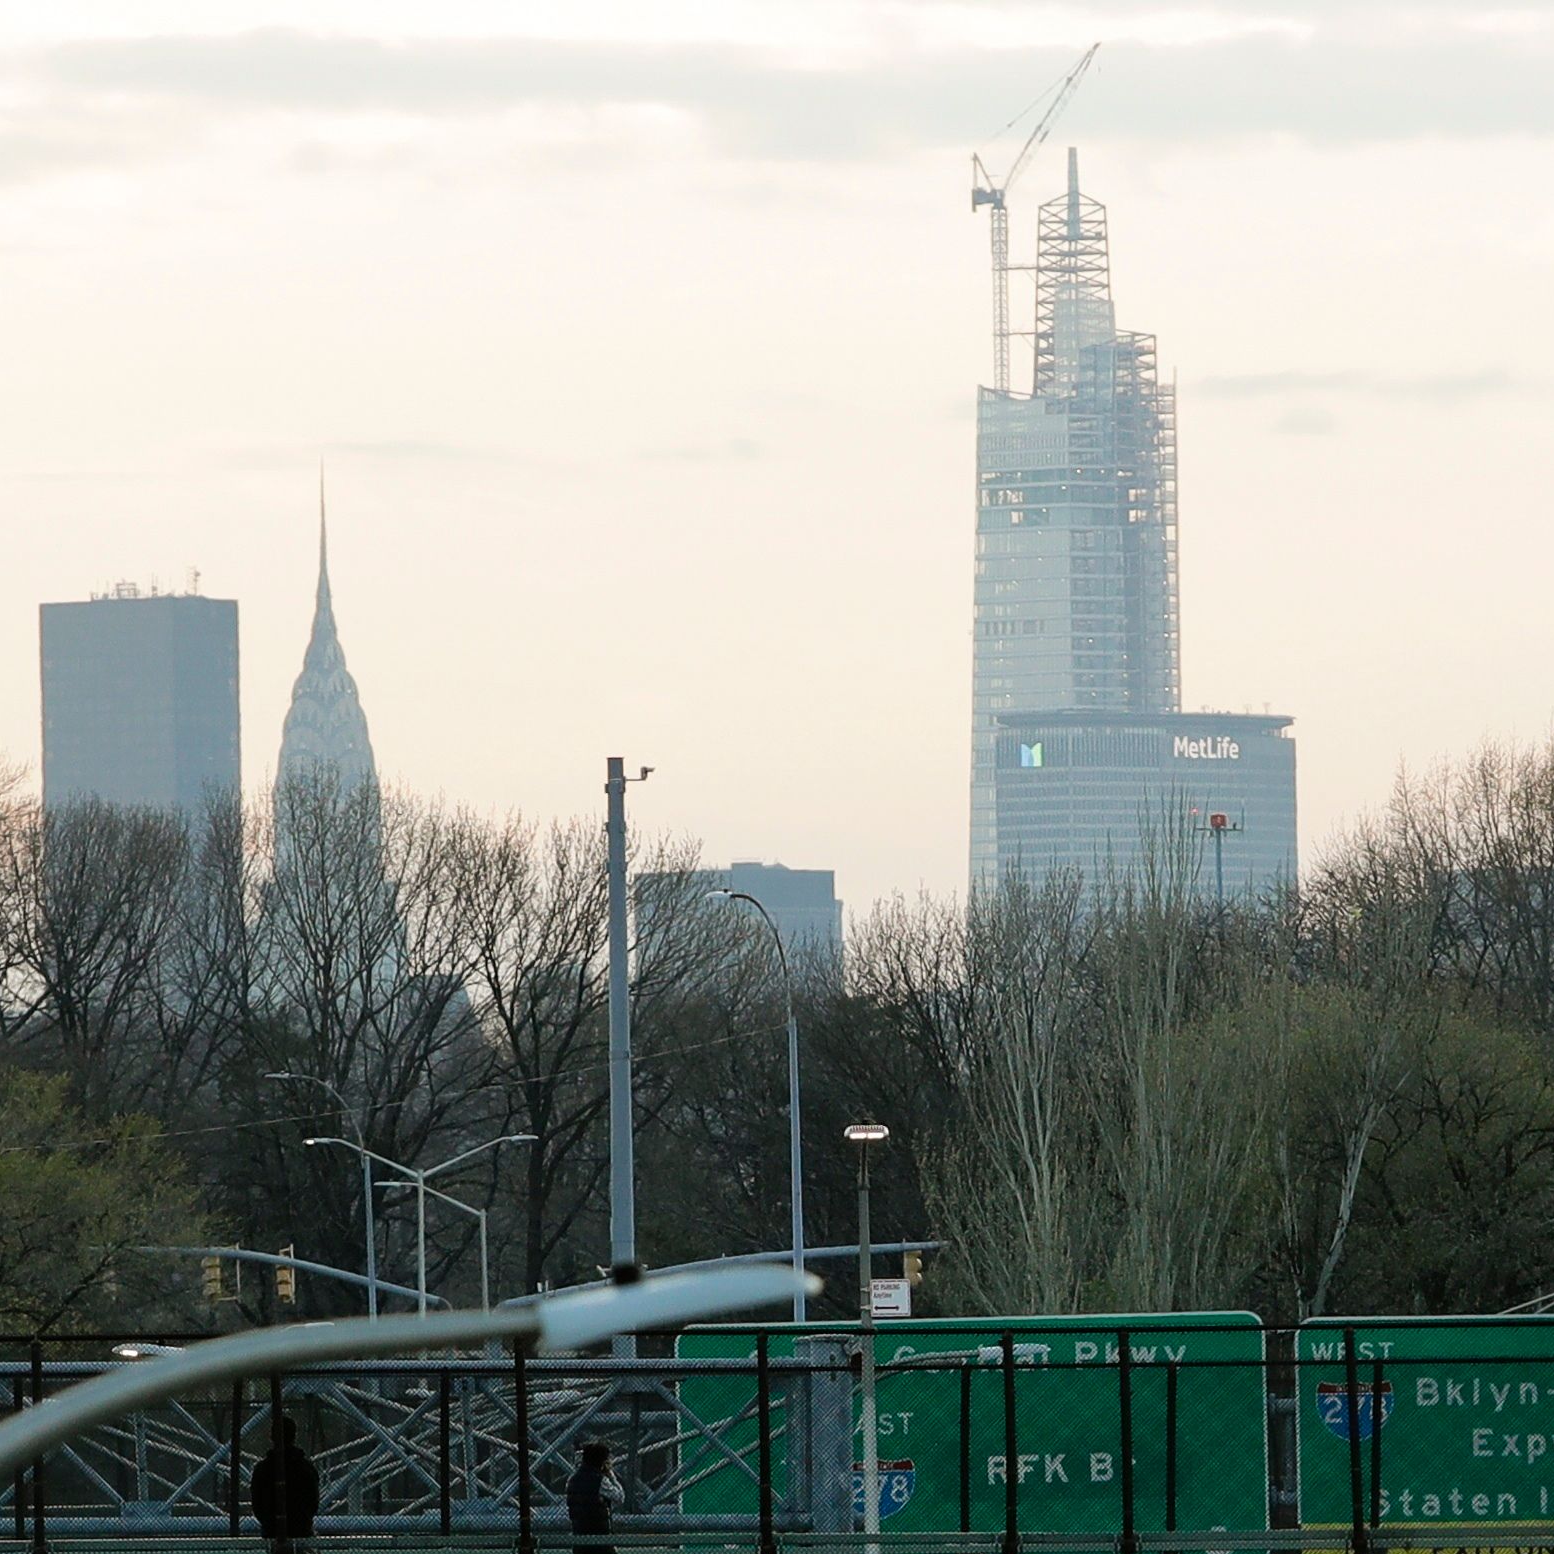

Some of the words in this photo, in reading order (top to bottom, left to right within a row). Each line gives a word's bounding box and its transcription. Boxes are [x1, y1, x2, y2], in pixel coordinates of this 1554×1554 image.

[1174, 736, 1239, 759] MetLife
[1075, 1341, 1187, 1371] Pkwy
[1311, 1341, 1394, 1361] WEST
[987, 1453, 1068, 1485] RFK
[1376, 1486, 1518, 1516] Staten
